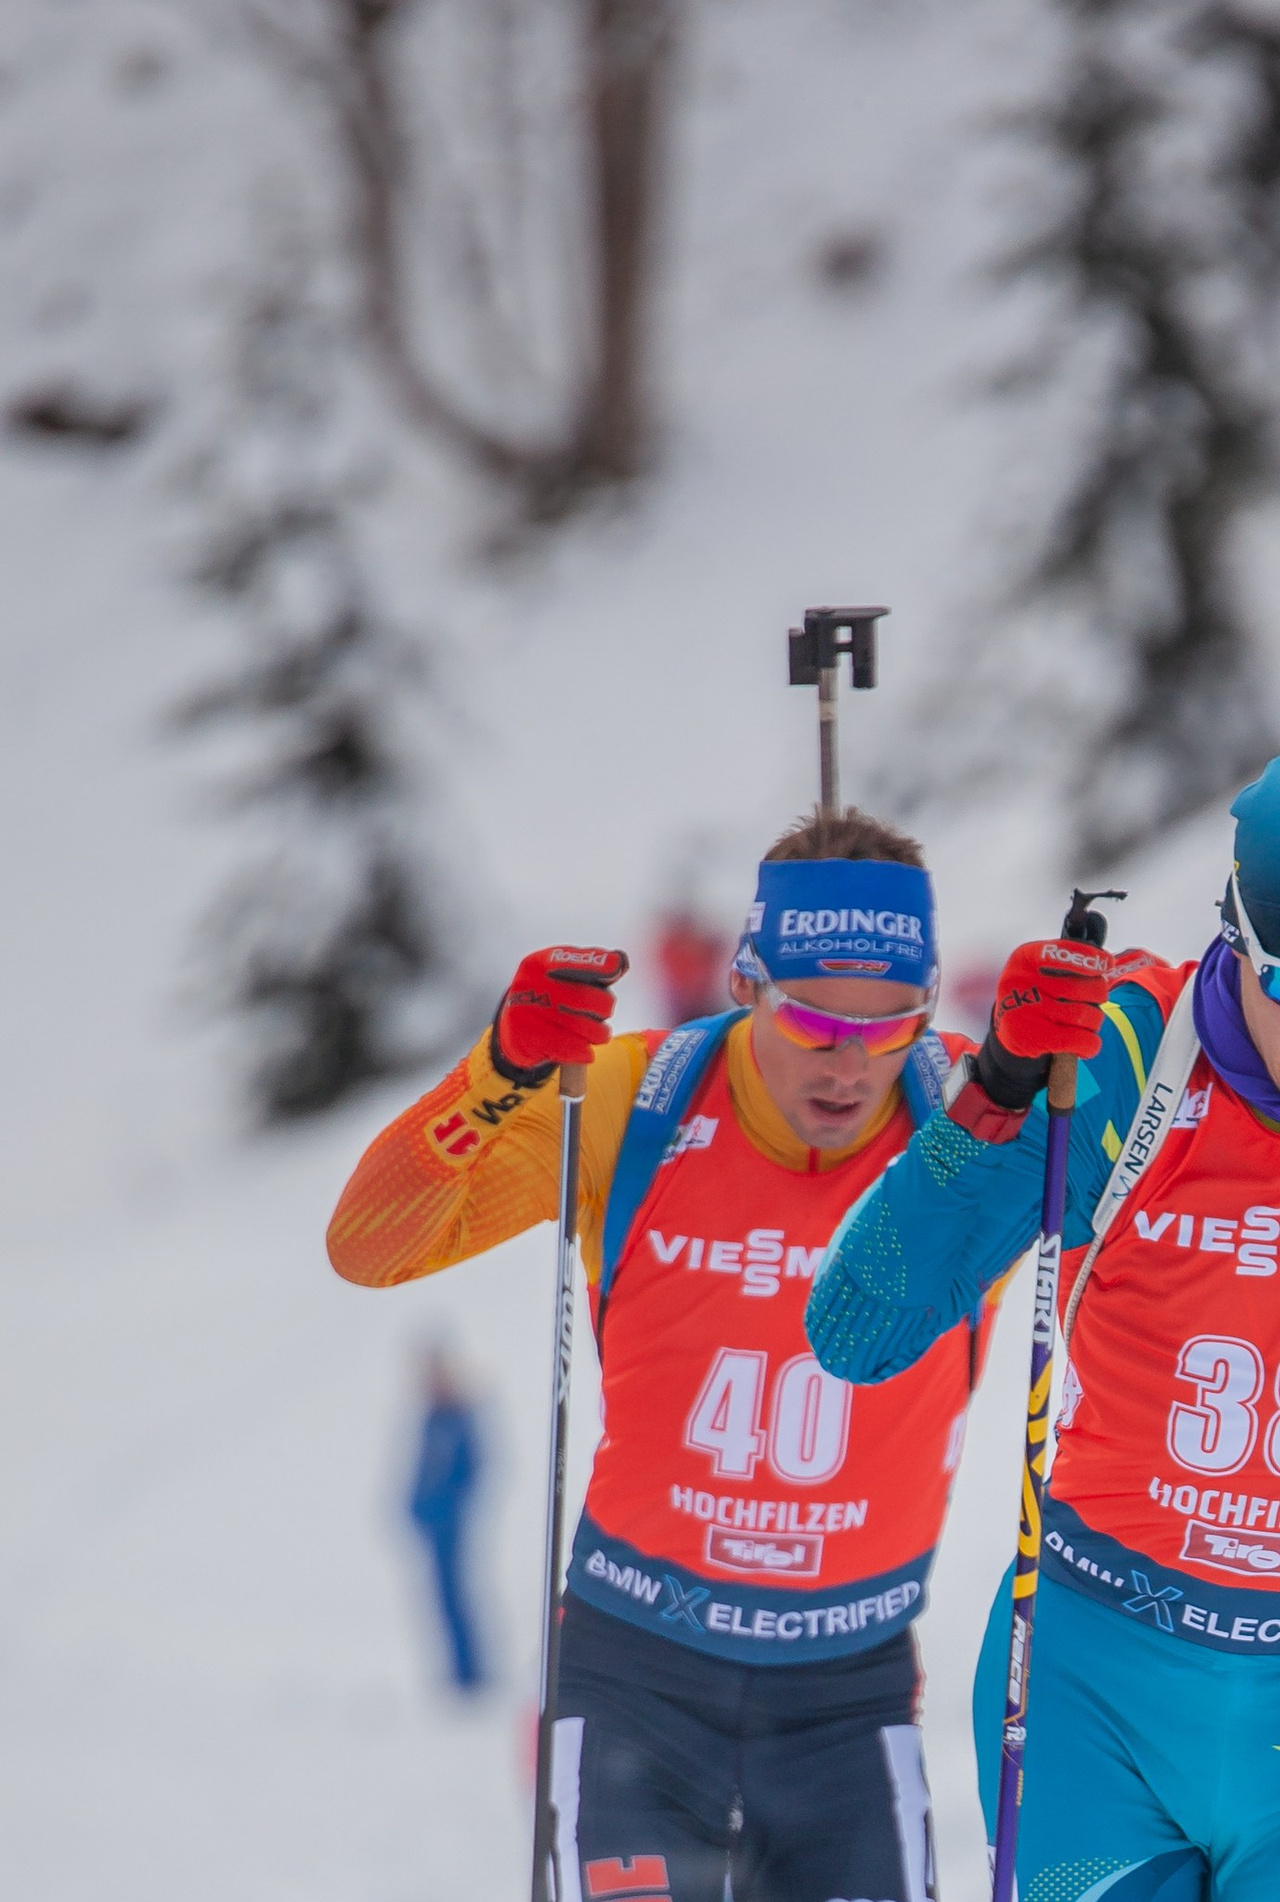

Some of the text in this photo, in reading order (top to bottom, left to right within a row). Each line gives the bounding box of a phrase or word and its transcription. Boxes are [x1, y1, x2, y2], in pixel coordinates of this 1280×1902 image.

[780, 908, 924, 945] ERDINGER
[780, 937, 922, 959] ALKOHOLFREI
[1124, 1082, 1173, 1176] LARSEN
[648, 1228, 829, 1297] VIESSM
[684, 1347, 853, 1484] 40
[670, 1484, 868, 1532] HOCHFILZEN
[585, 1549, 662, 1605] BMW
[707, 1580, 921, 1640] ELECTRIFIED
